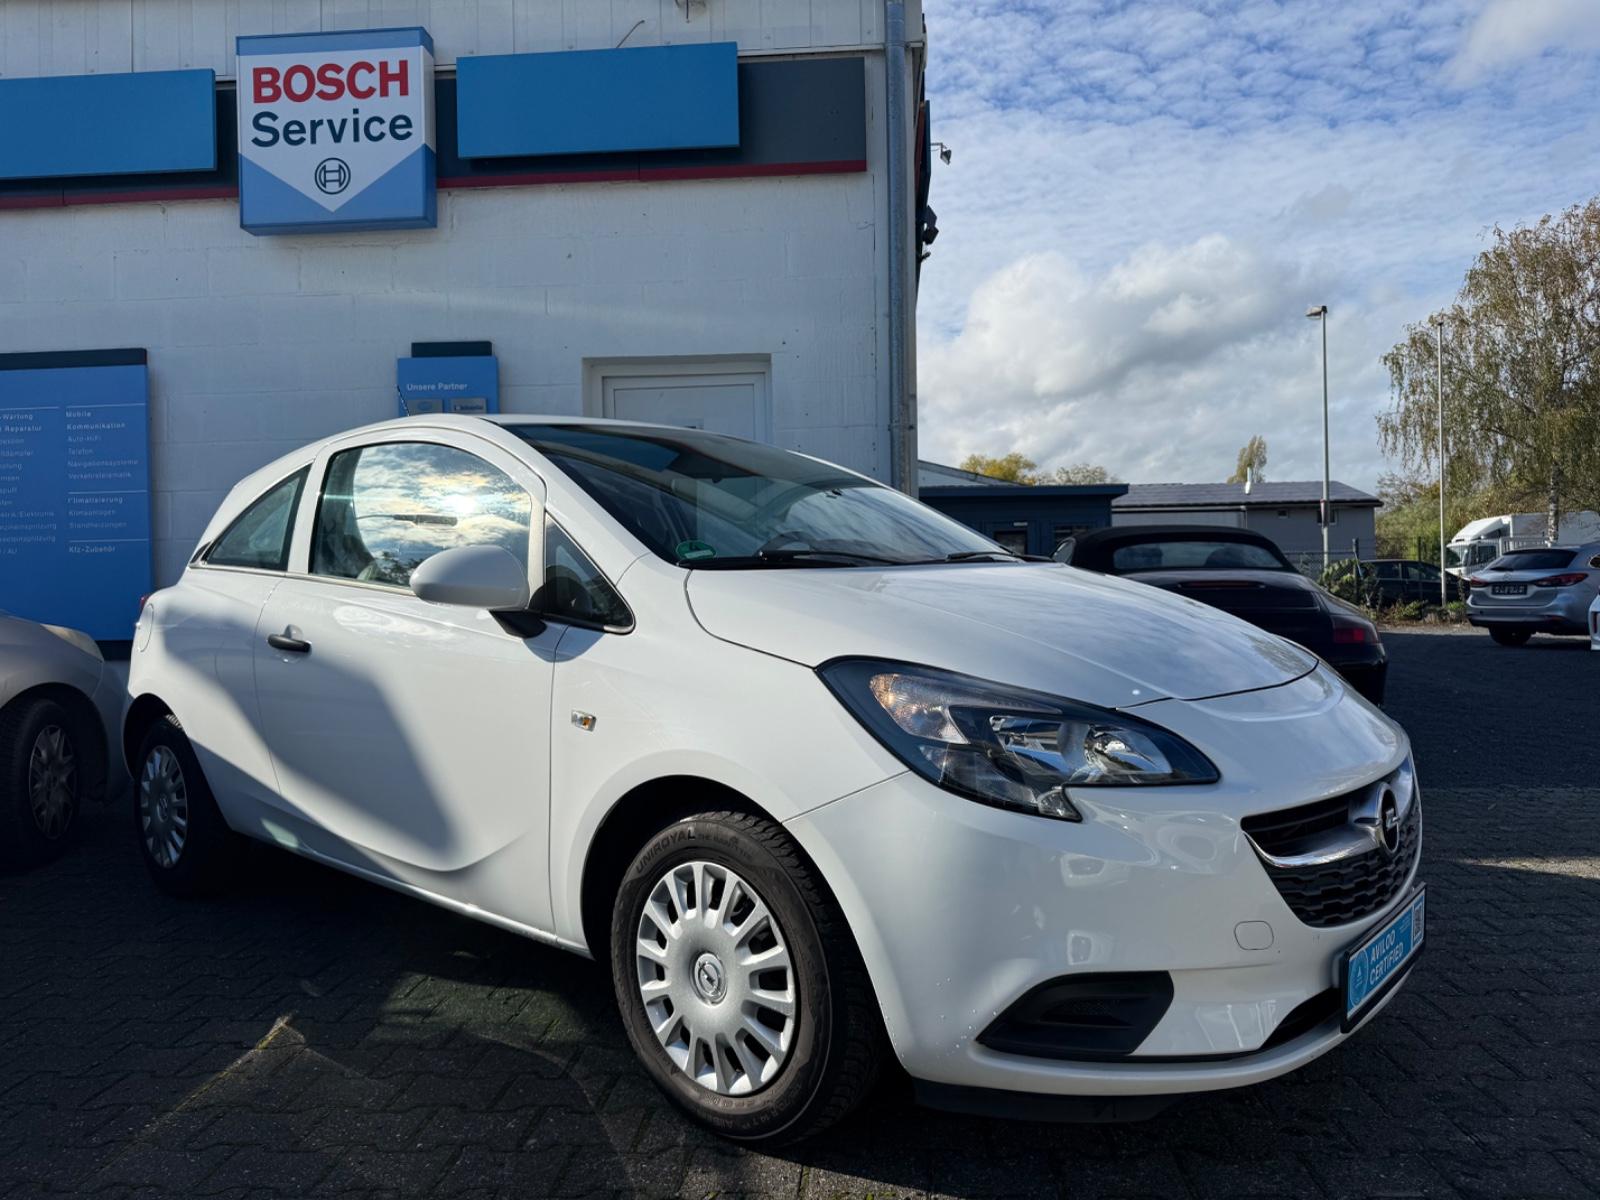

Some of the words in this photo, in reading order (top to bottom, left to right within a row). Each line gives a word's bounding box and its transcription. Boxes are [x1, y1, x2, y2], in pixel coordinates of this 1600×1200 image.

[252, 60, 409, 103] BOSCH
[251, 108, 413, 147] Service
[406, 383, 436, 391] Unsere
[438, 382, 468, 391] Partner
[4, 425, 42, 433] Reparatur
[66, 422, 125, 431] Kommunikation
[636, 829, 696, 874] UNIROYAL
[1370, 942, 1404, 984] CERTIFIED
[1371, 929, 1395, 964] AVILOO
